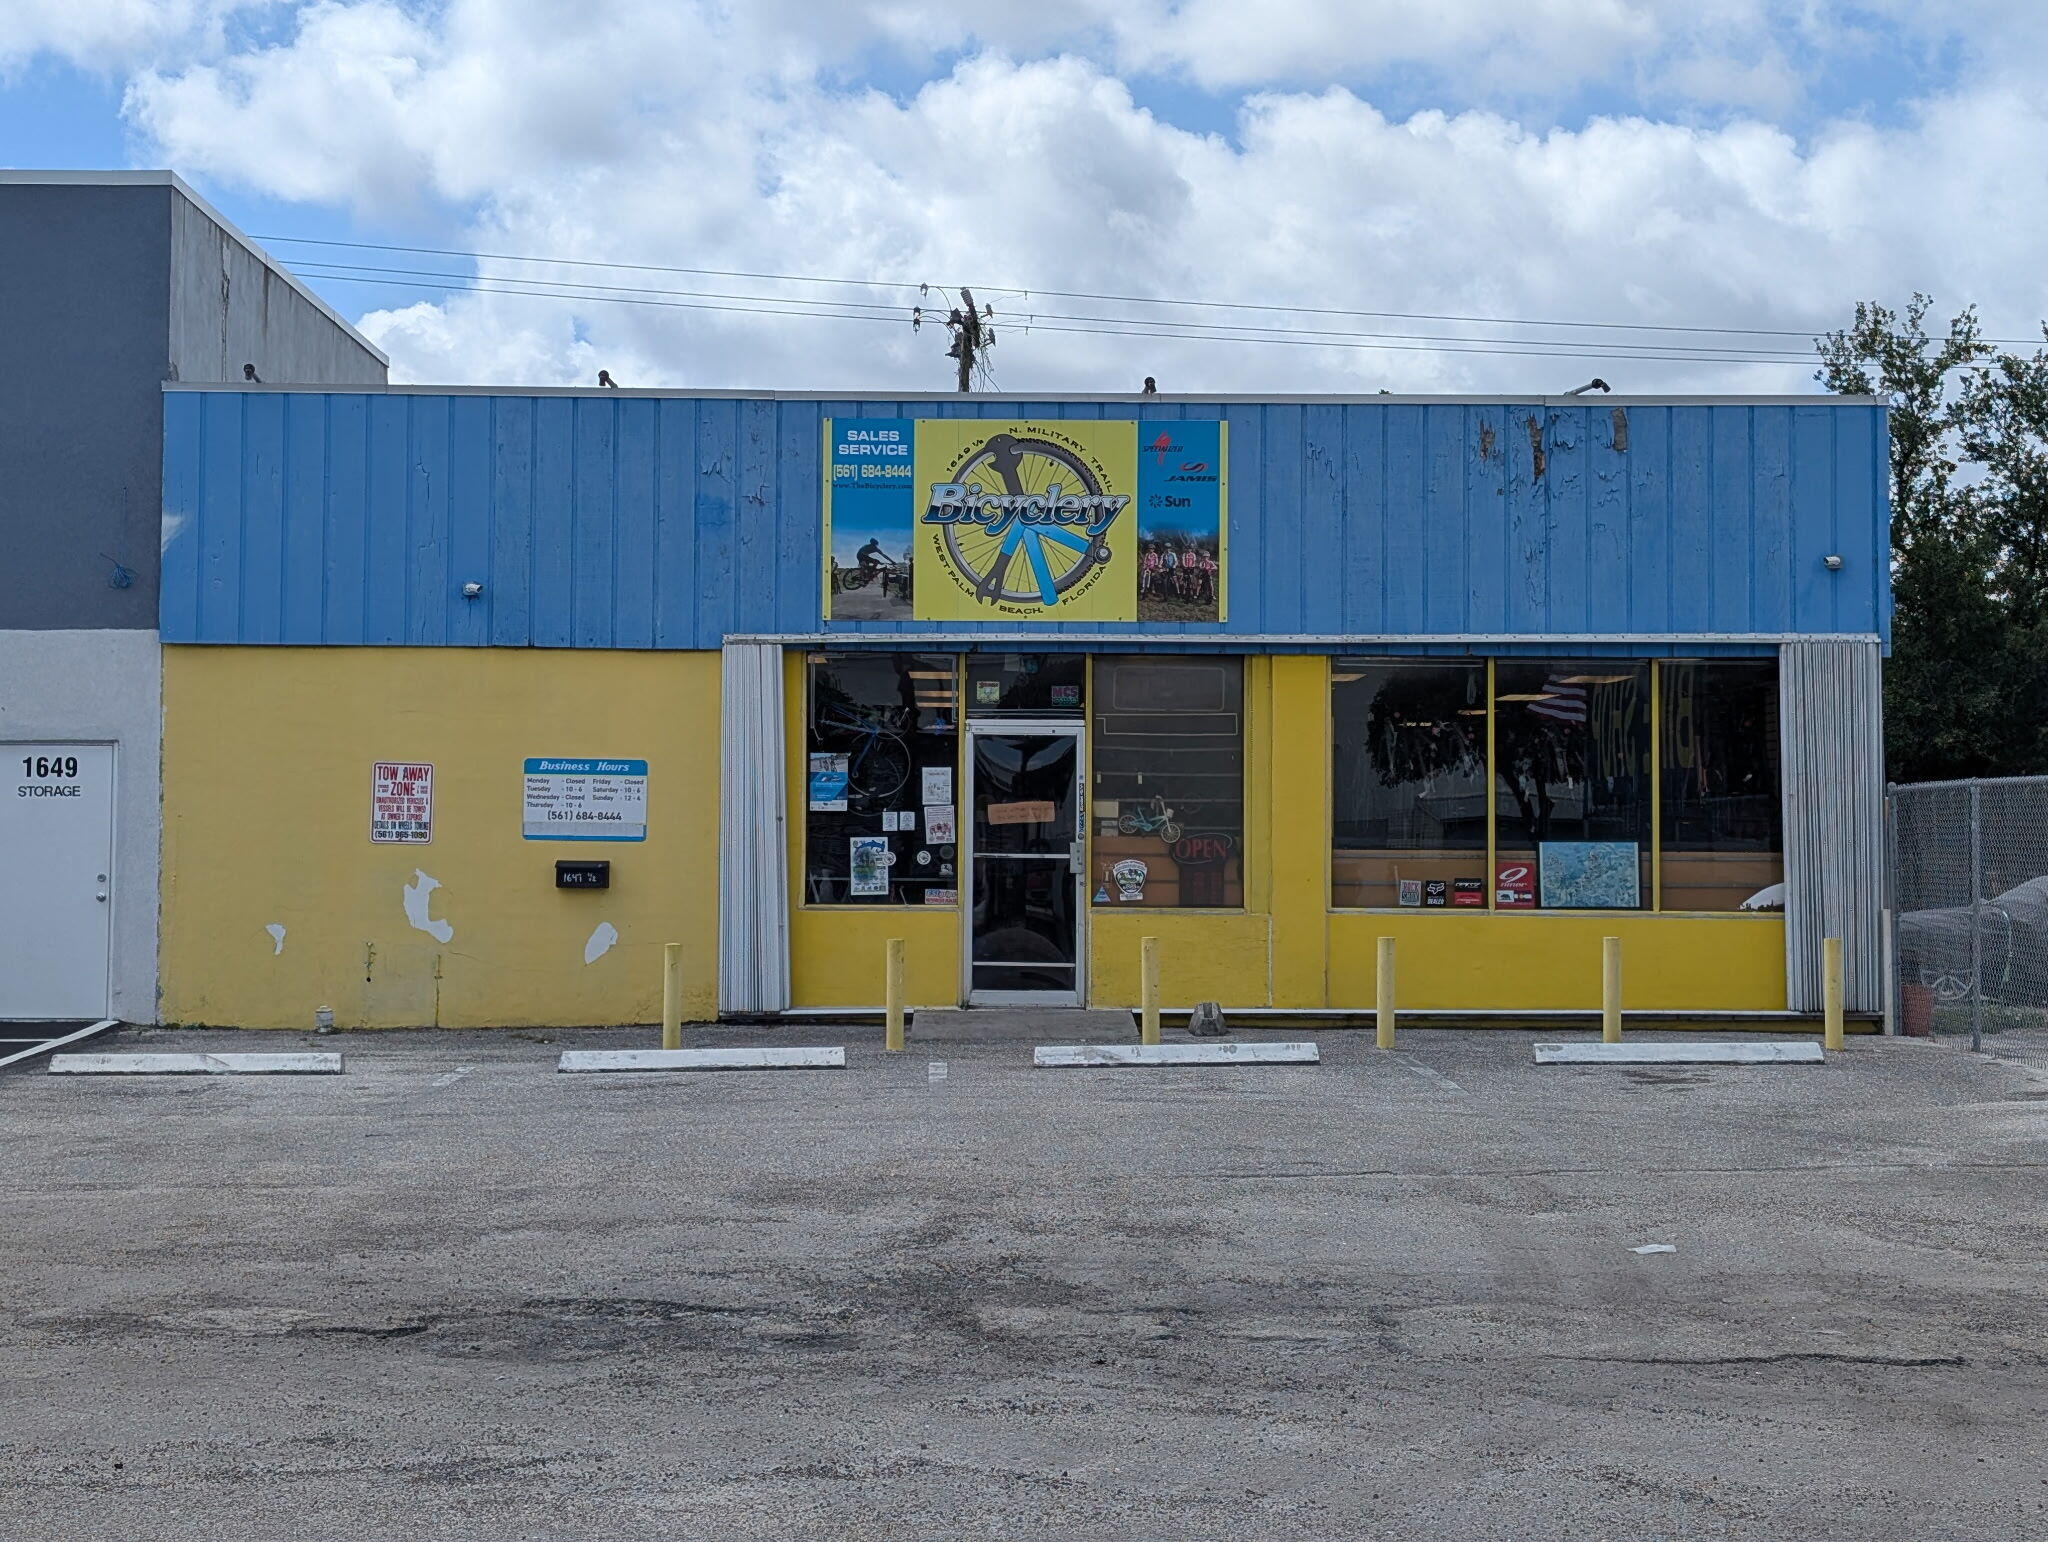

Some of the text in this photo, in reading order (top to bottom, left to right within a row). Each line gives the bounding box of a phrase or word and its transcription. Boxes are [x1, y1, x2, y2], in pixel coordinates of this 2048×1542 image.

[847, 430, 900, 441] SALES
[838, 444, 908, 456] SERVICE
[946, 447, 971, 473] 1649
[1027, 427, 1086, 453] MILITARY
[1091, 456, 1113, 493] TRAIL
[861, 464, 912, 478] 684-8444
[1164, 495, 1191, 508] Sun
[920, 482, 1132, 537] Bicyclery
[932, 533, 951, 568] WEST
[948, 570, 975, 597] PALM
[1061, 565, 1107, 606] FLORIDA
[1053, 686, 1078, 697] MCS
[22, 756, 78, 778] 1649
[539, 761, 630, 772] Business Hours
[377, 766, 430, 782] TOW AWAY
[18, 785, 81, 797] STORAGE
[390, 781, 416, 796] ZONE
[548, 810, 622, 821] (561) 684-8444
[375, 830, 394, 839] (561)
[1175, 838, 1227, 859] OPEN
